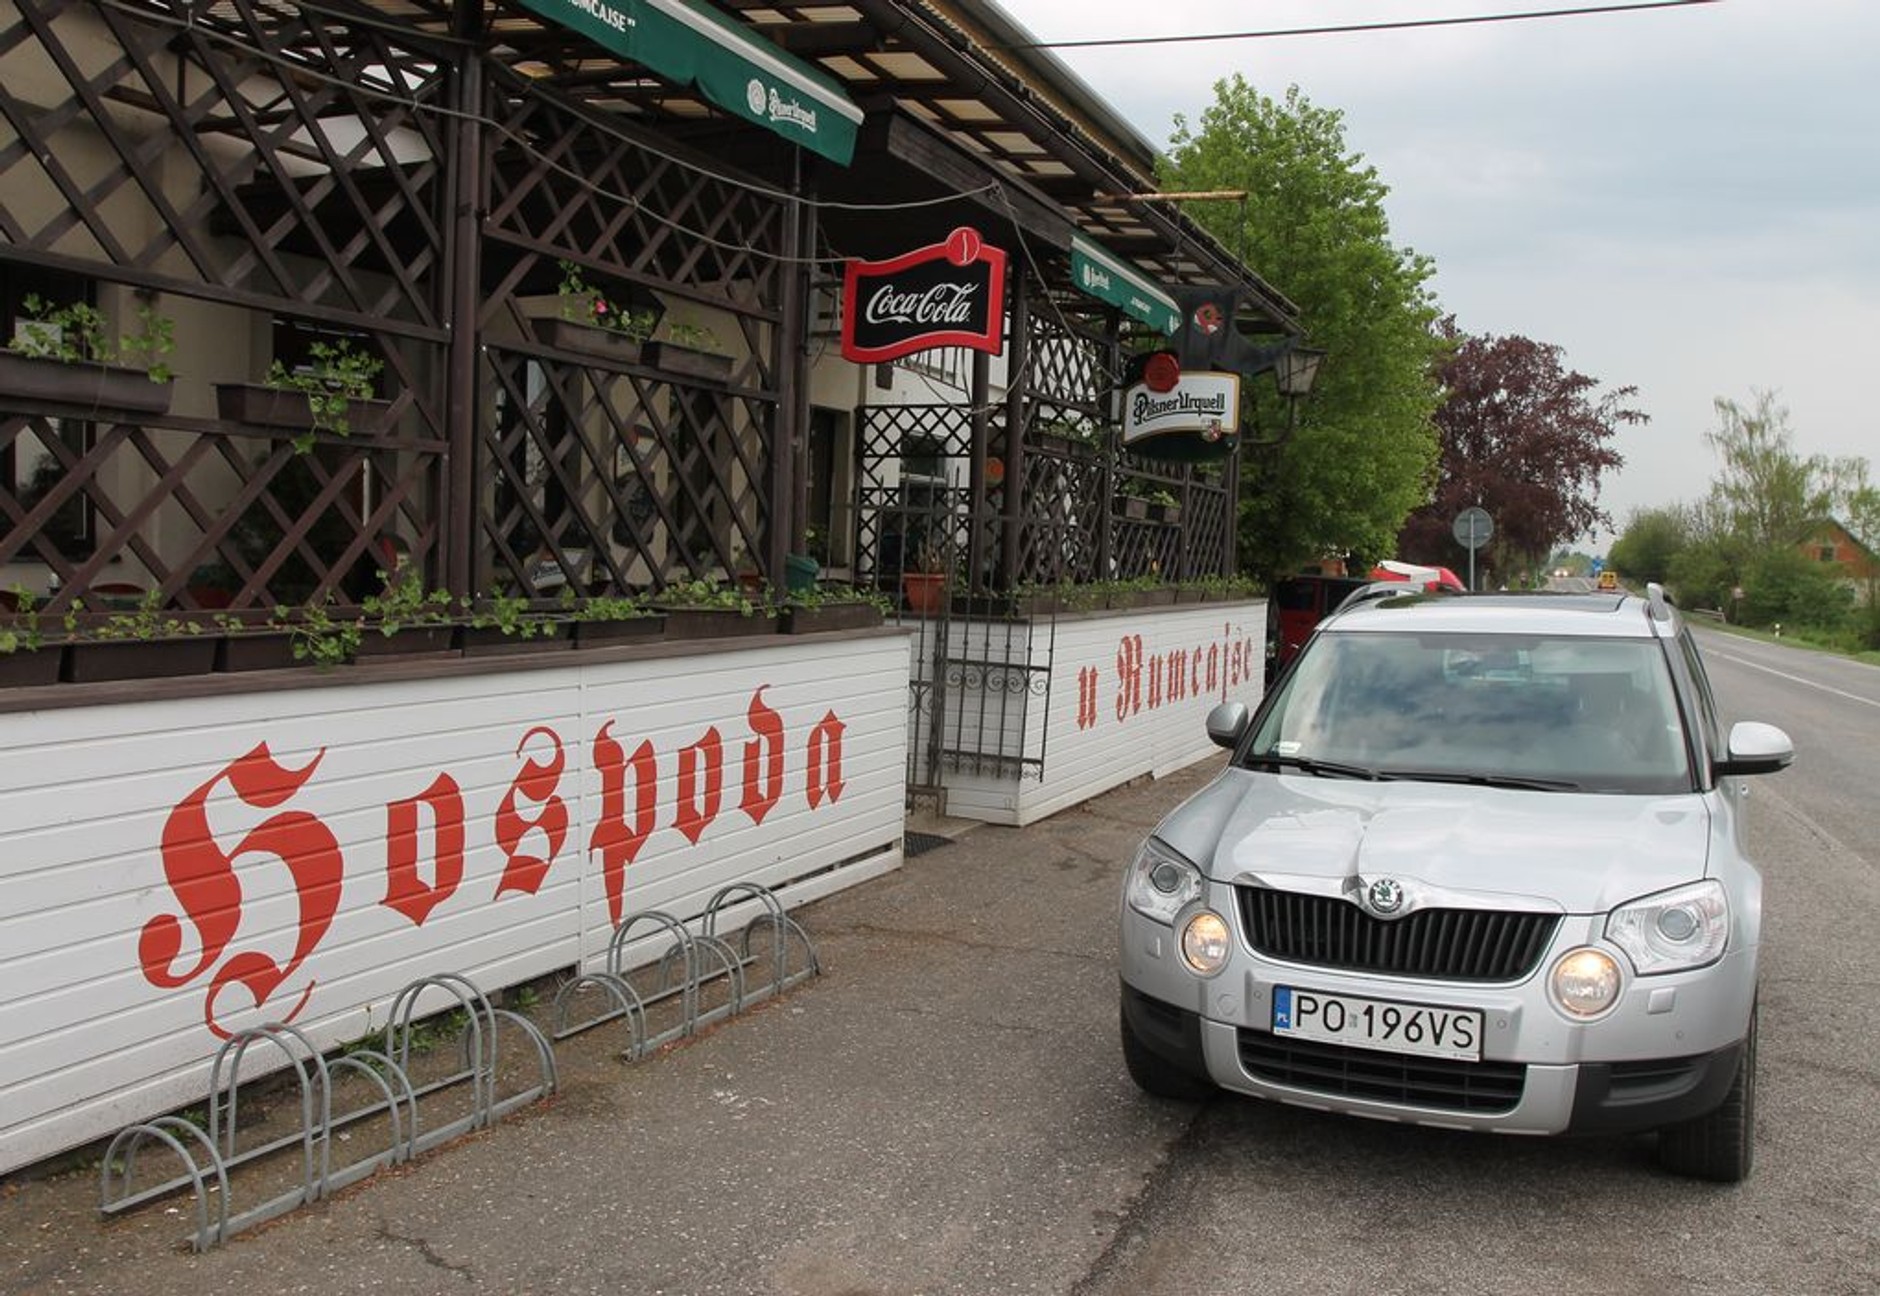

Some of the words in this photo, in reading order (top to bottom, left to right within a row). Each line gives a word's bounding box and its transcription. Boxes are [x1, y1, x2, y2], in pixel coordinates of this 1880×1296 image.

[866, 283, 981, 325] Coca-Cola
[1133, 391, 1180, 427] Pilsner
[1178, 388, 1226, 418] Urquell
[137, 684, 847, 1044] Hospoda
[1296, 994, 1346, 1033] PO
[1363, 1003, 1474, 1050] 196VS
